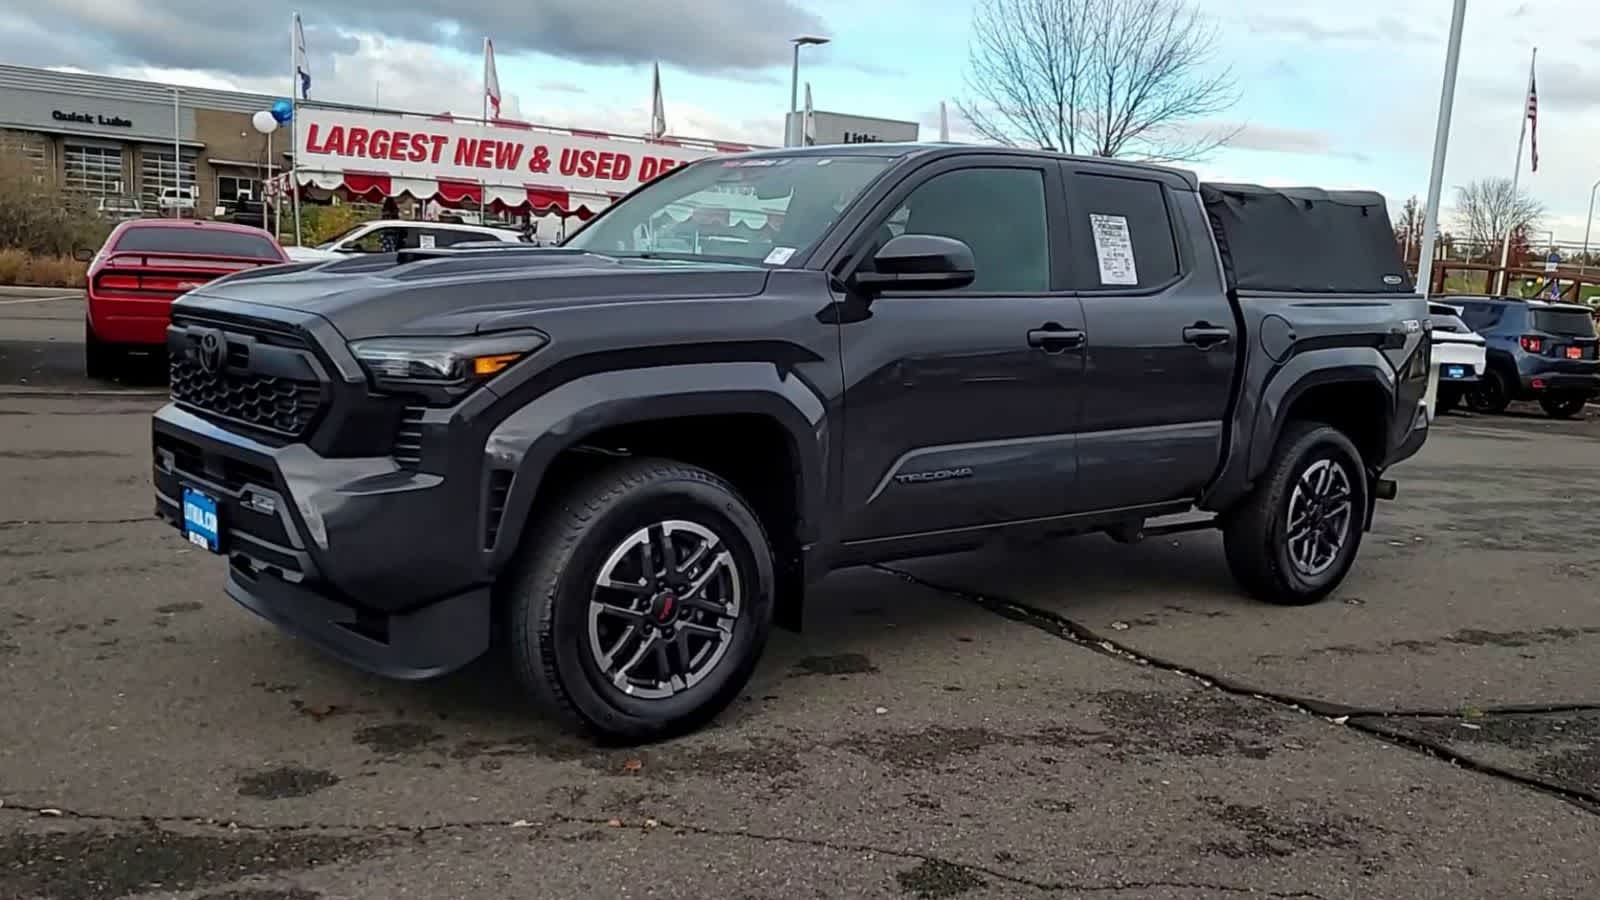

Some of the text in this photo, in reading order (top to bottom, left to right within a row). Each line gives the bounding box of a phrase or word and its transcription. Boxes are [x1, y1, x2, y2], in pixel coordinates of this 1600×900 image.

[52, 110, 132, 128] Quick Lube
[306, 123, 449, 164] LARGEST
[453, 137, 524, 170] NEW
[528, 145, 552, 174] &
[559, 148, 632, 181] USED
[895, 467, 973, 482] TACOMA
